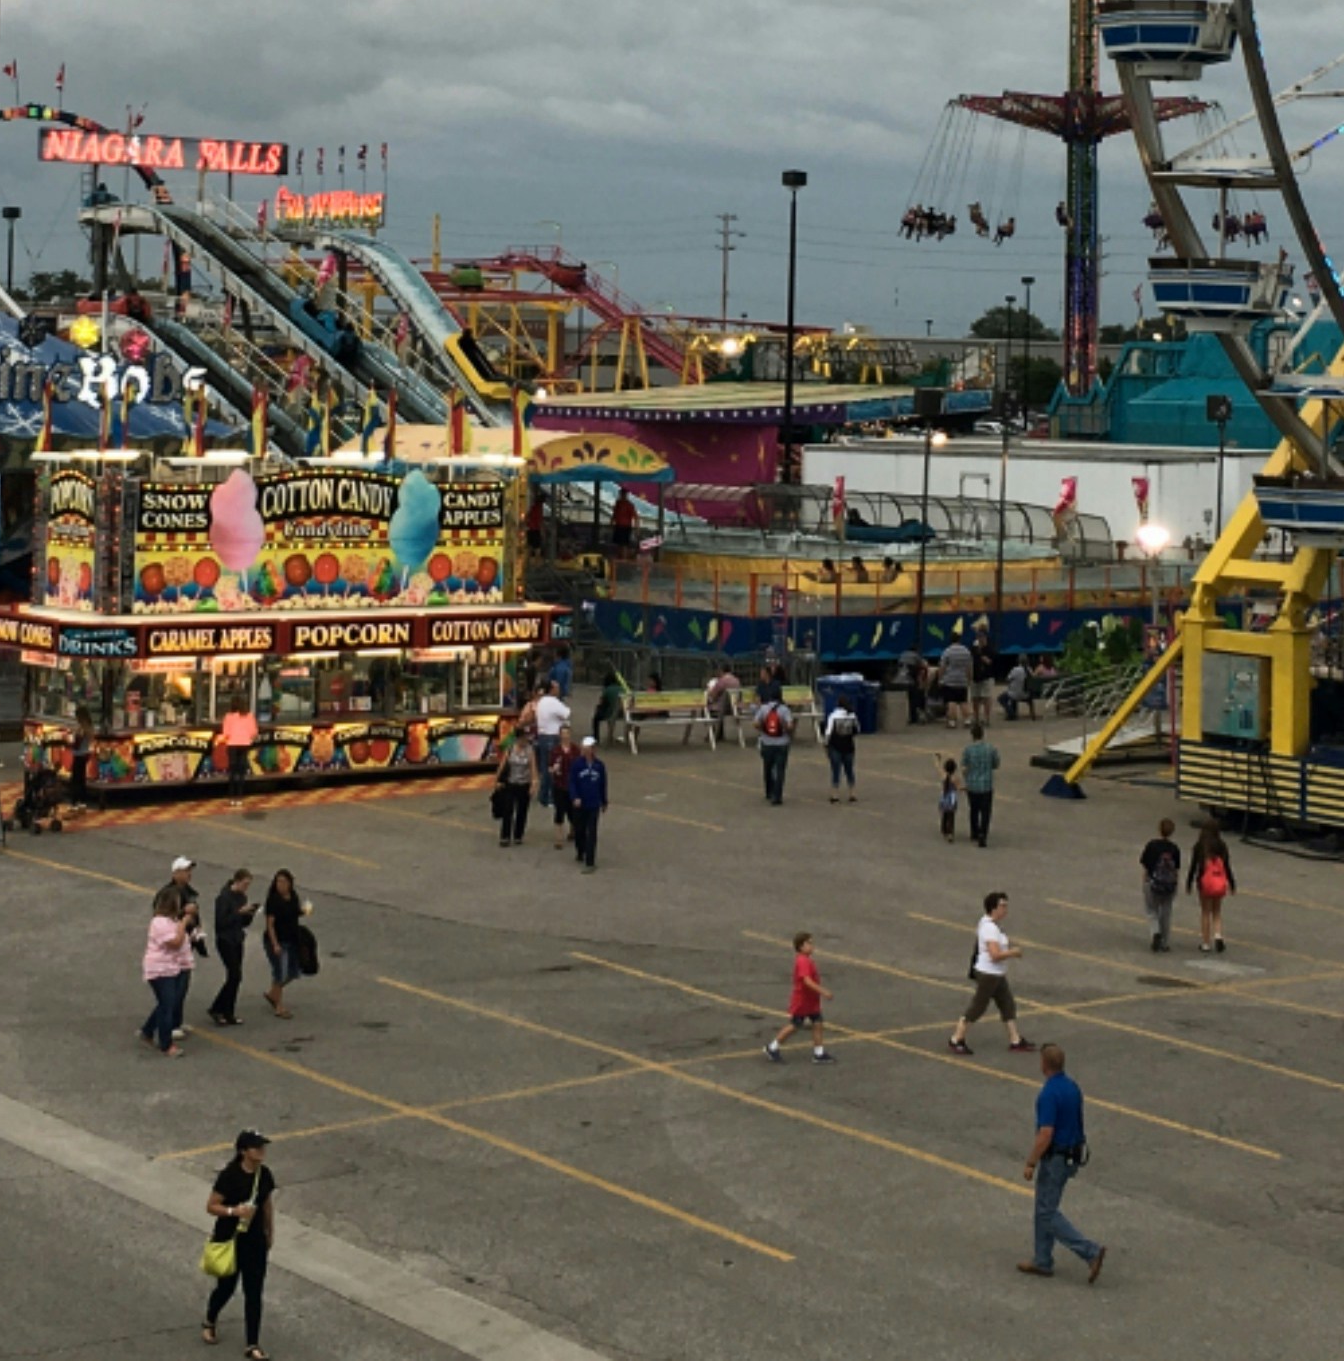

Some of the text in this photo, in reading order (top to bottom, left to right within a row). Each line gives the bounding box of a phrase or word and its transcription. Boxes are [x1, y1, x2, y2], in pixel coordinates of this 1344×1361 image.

[43, 131, 283, 174] NIAGARA FALLS
[141, 492, 208, 511] SNOW
[261, 477, 394, 517] COTTON CANDY
[443, 491, 501, 508] CANDY
[141, 511, 208, 529] CONES
[442, 509, 502, 527] APPLES
[21, 622, 53, 649] CONES
[149, 626, 273, 653] CARAMEL APPLES
[294, 623, 410, 647] POPCORN
[431, 618, 492, 642] COTTON
[493, 616, 542, 640] CANDY
[59, 634, 138, 656] DRINKS
